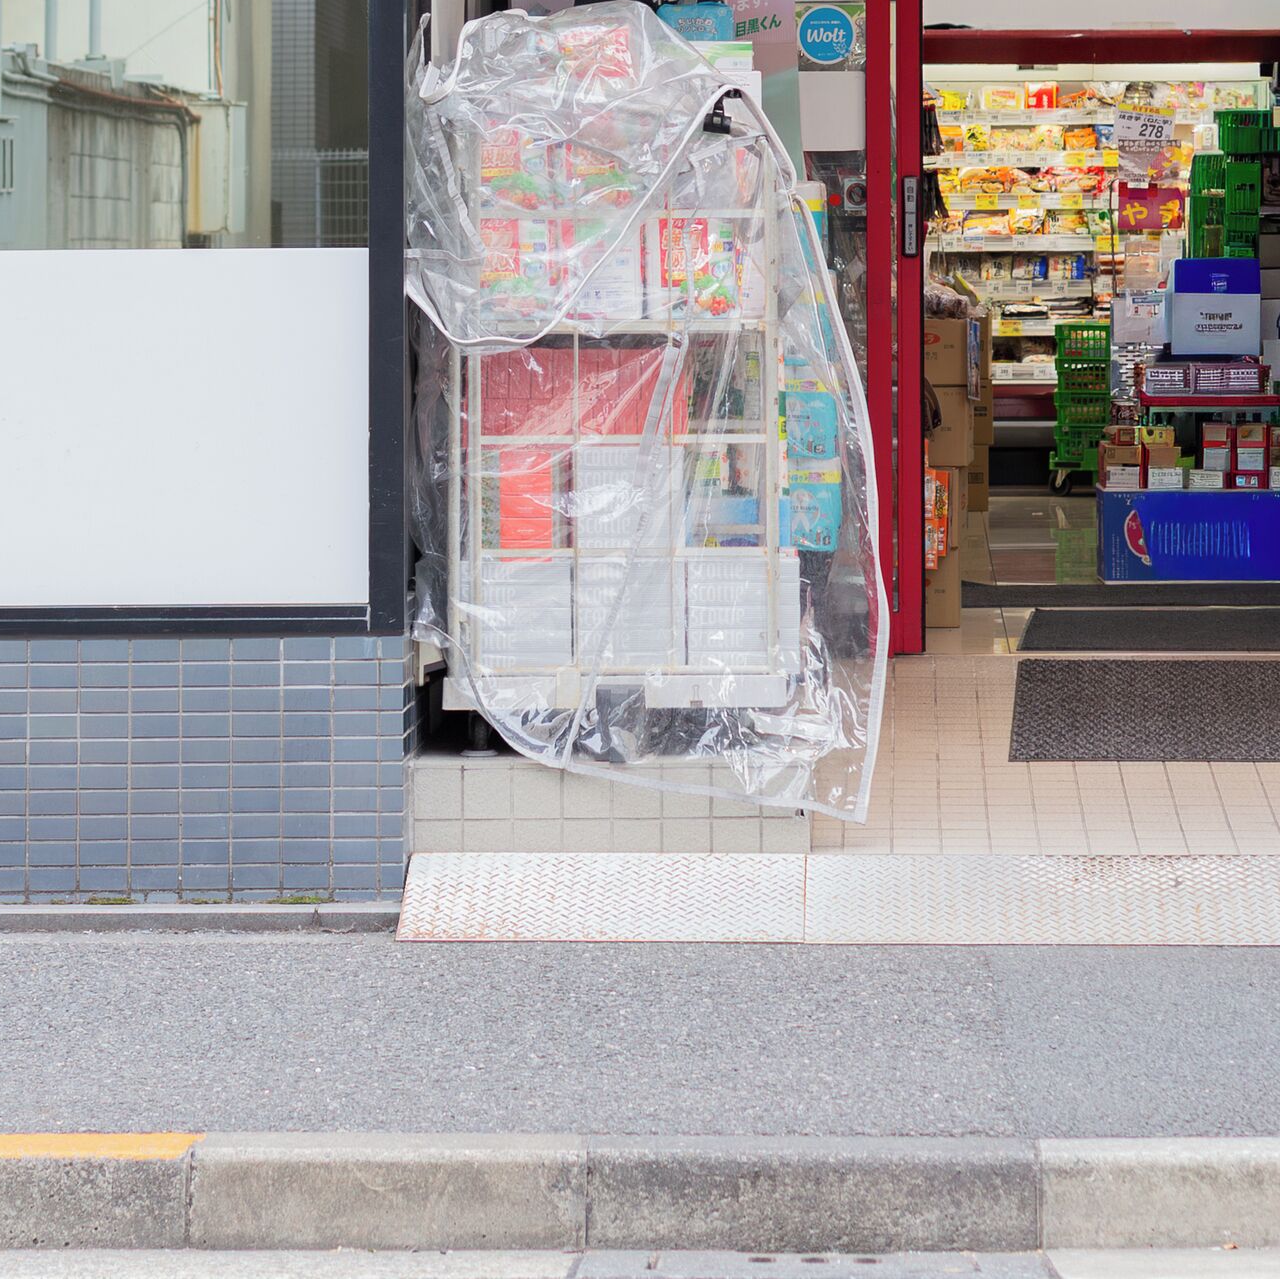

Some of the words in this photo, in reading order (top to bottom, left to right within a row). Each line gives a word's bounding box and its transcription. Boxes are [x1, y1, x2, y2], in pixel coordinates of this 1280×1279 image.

[735, 14, 781, 38] 目黒くん
[806, 27, 846, 43] Wolt
